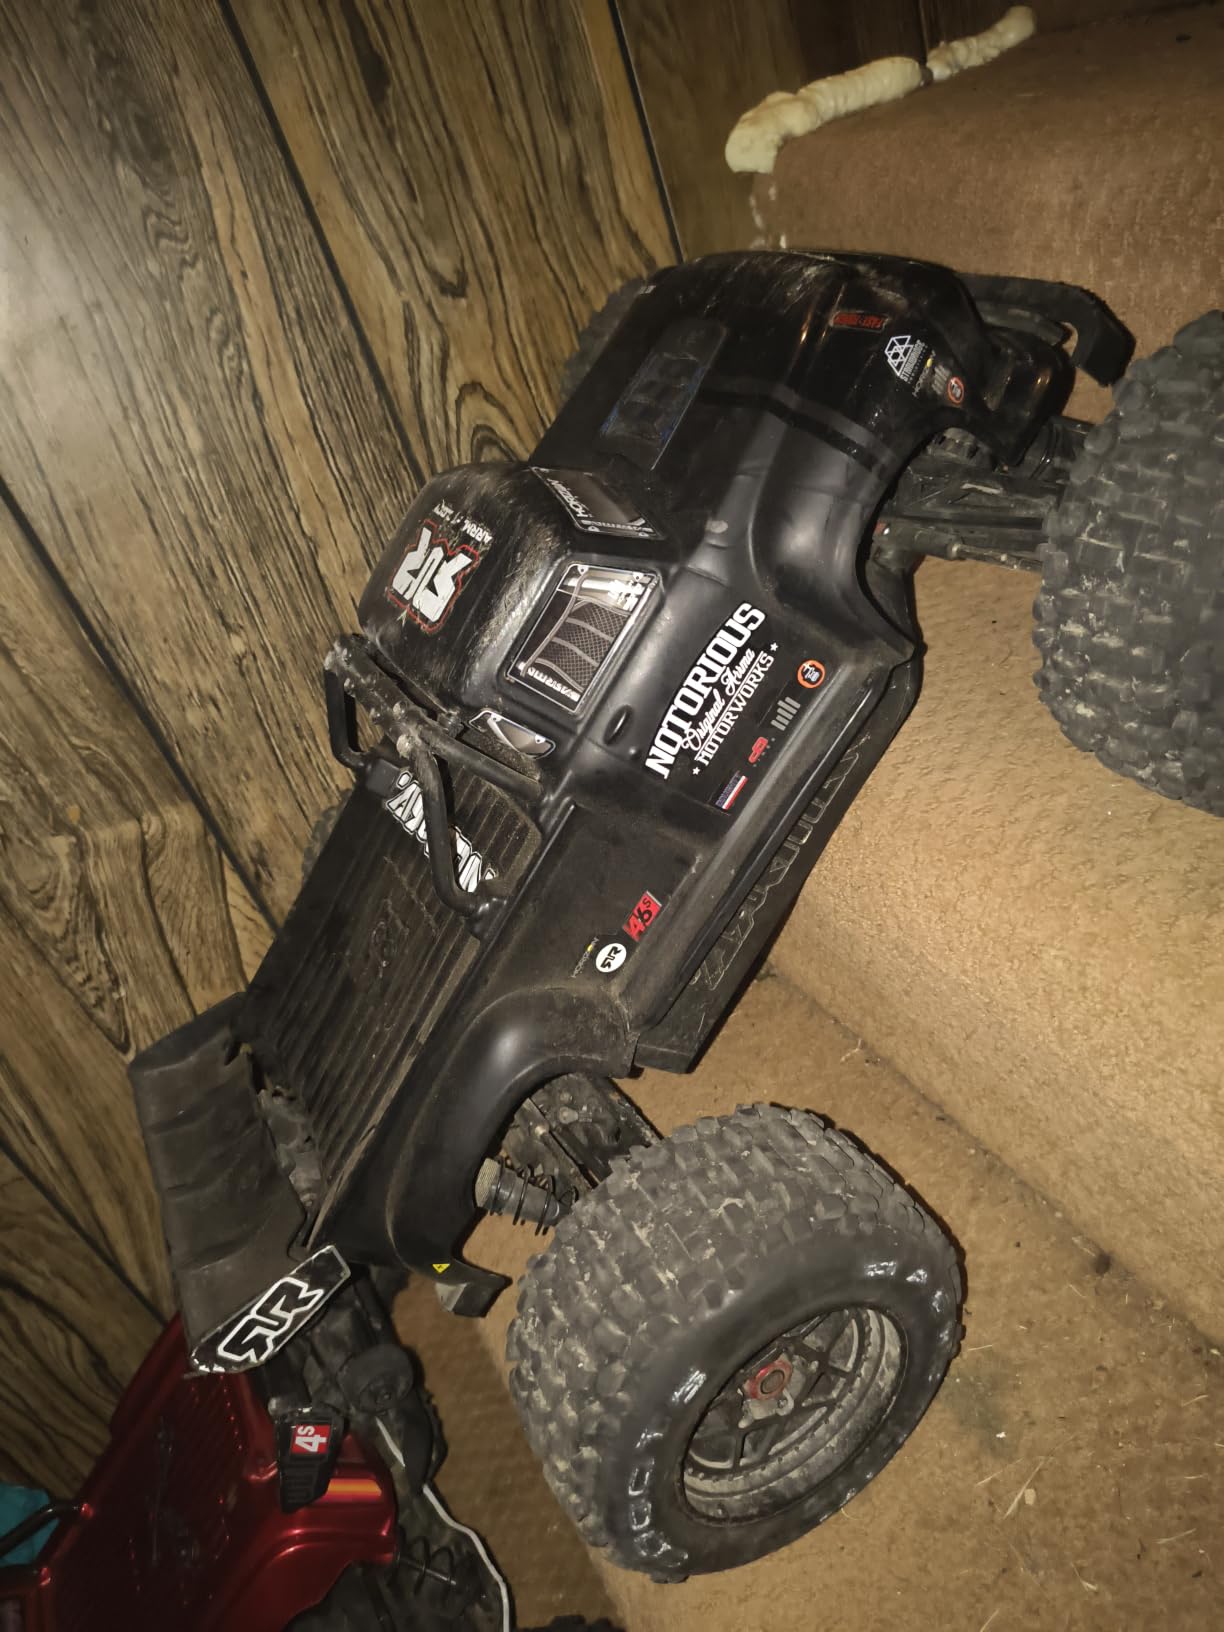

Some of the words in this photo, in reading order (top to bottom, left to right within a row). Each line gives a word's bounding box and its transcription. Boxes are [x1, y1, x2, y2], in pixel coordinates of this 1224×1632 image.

[645, 602, 766, 779] NOTORIOUS
[681, 689, 725, 750] Original
[721, 648, 755, 696] Arrma
[695, 651, 775, 767] MOTORWORKS
[295, 1425, 328, 1452] 4S
